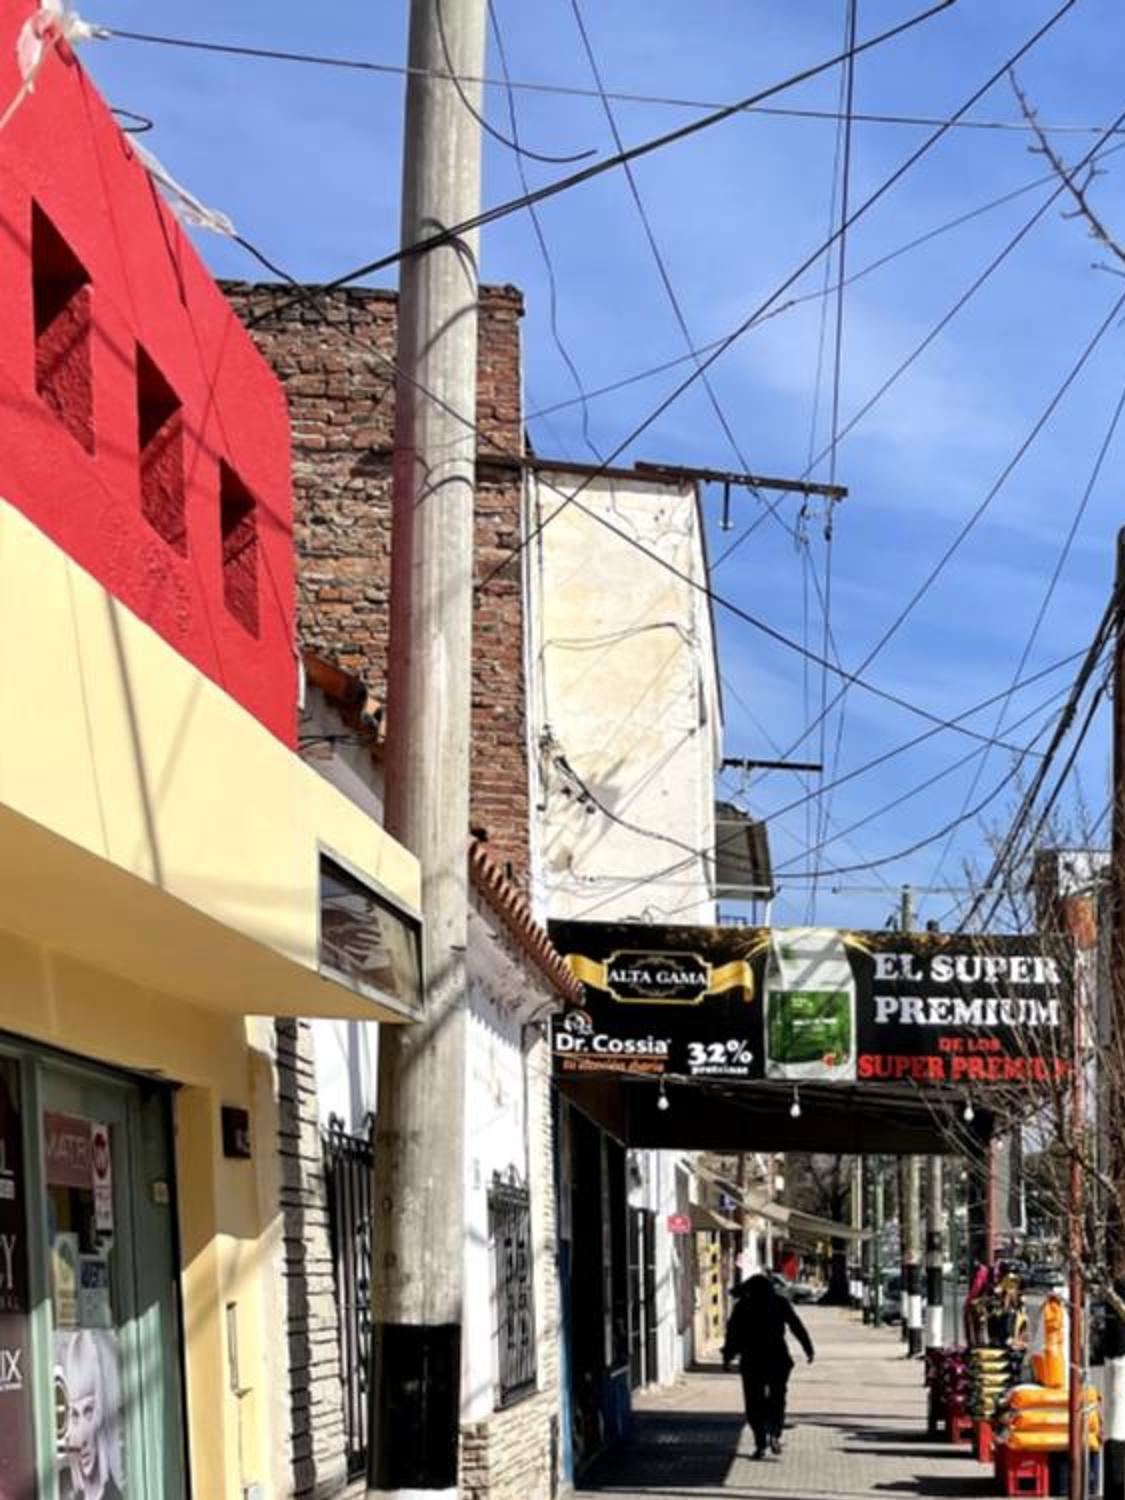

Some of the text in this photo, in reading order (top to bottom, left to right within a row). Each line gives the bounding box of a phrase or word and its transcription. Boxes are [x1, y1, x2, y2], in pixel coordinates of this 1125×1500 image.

[608, 969, 706, 985] ALTA GAMA
[873, 953, 1061, 984] EL SUPER
[873, 996, 1059, 1026] PREMIUM
[555, 1034, 669, 1055] Dr. Cossia
[687, 1039, 753, 1065] 32%
[858, 1055, 944, 1079] SUPER
